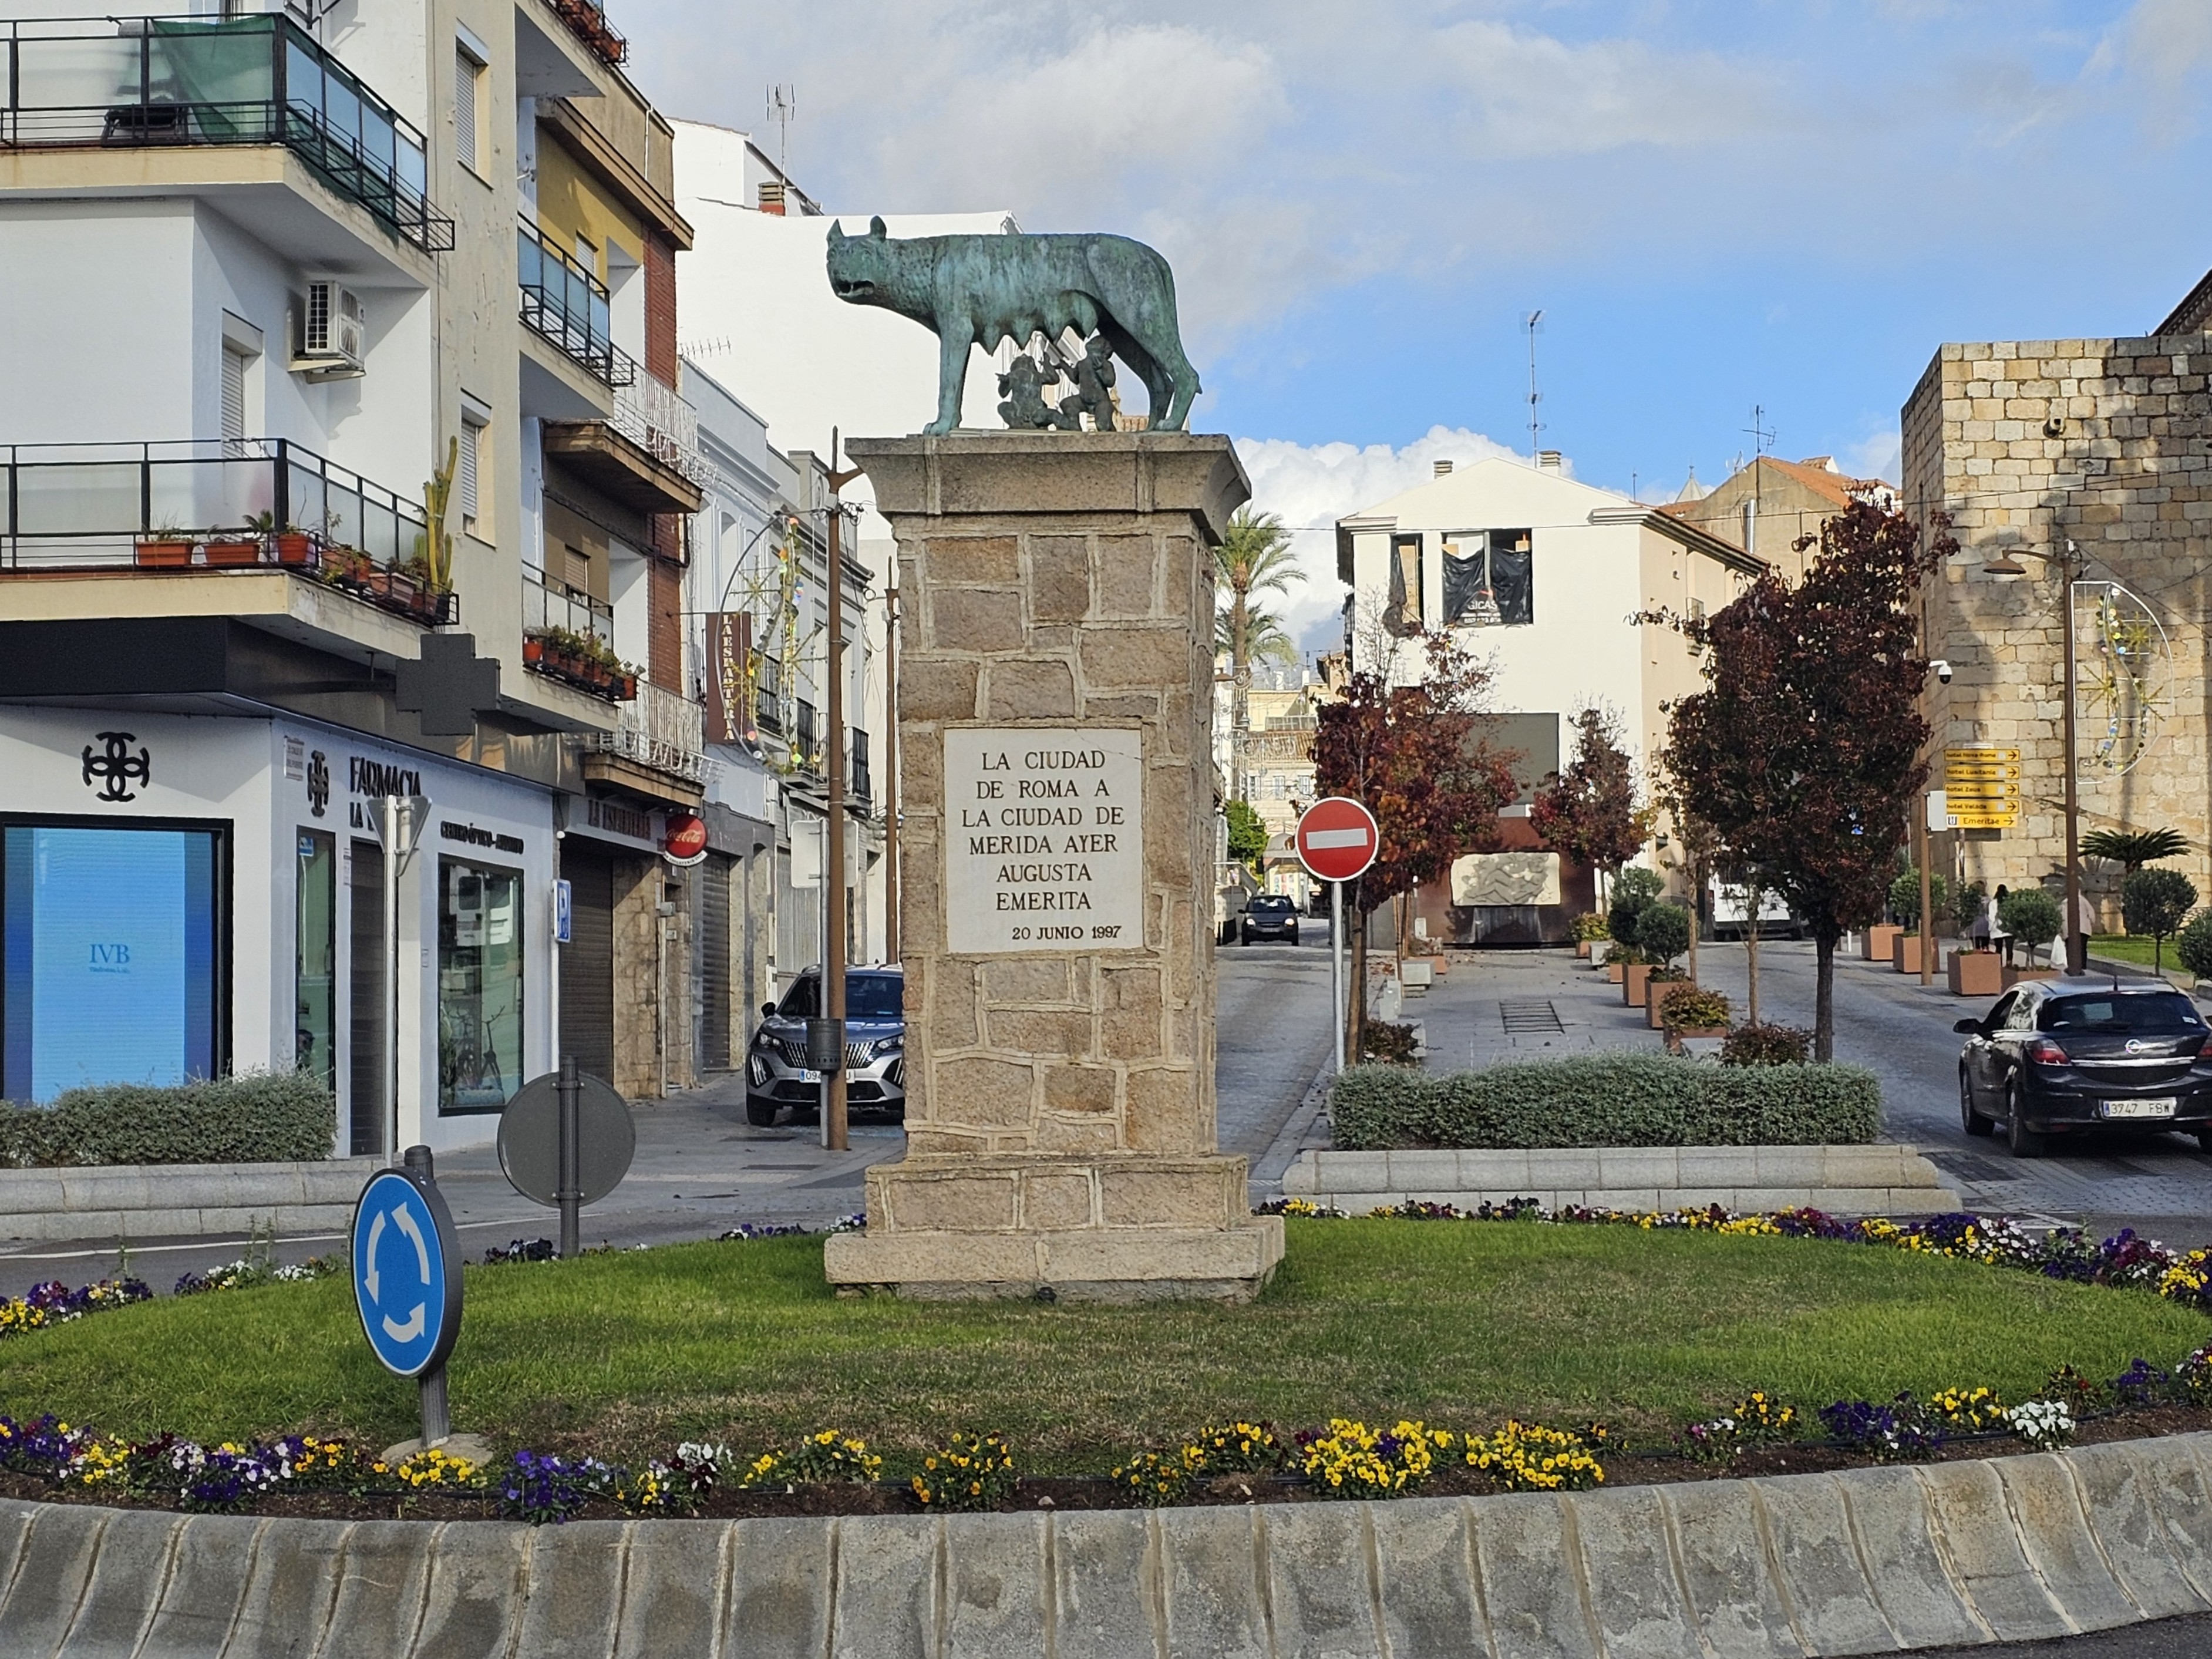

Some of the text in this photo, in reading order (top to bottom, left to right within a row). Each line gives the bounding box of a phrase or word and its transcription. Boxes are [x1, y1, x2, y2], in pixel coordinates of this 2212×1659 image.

[982, 750, 1106, 770] LA CIUDAD
[350, 756, 422, 798] FARMACIA
[976, 778, 1110, 799] DE ROMA A
[350, 801, 363, 829] LA
[961, 806, 1125, 827] LA CIUDAD DE
[666, 827, 702, 844] Coca-Cola
[969, 834, 1119, 855] MERIDA AYER
[996, 863, 1093, 883] AUGUSTA
[996, 891, 1092, 911] EMERITA
[1012, 925, 1122, 940] 20 JUNIO 1997
[89, 943, 130, 964] IVB
